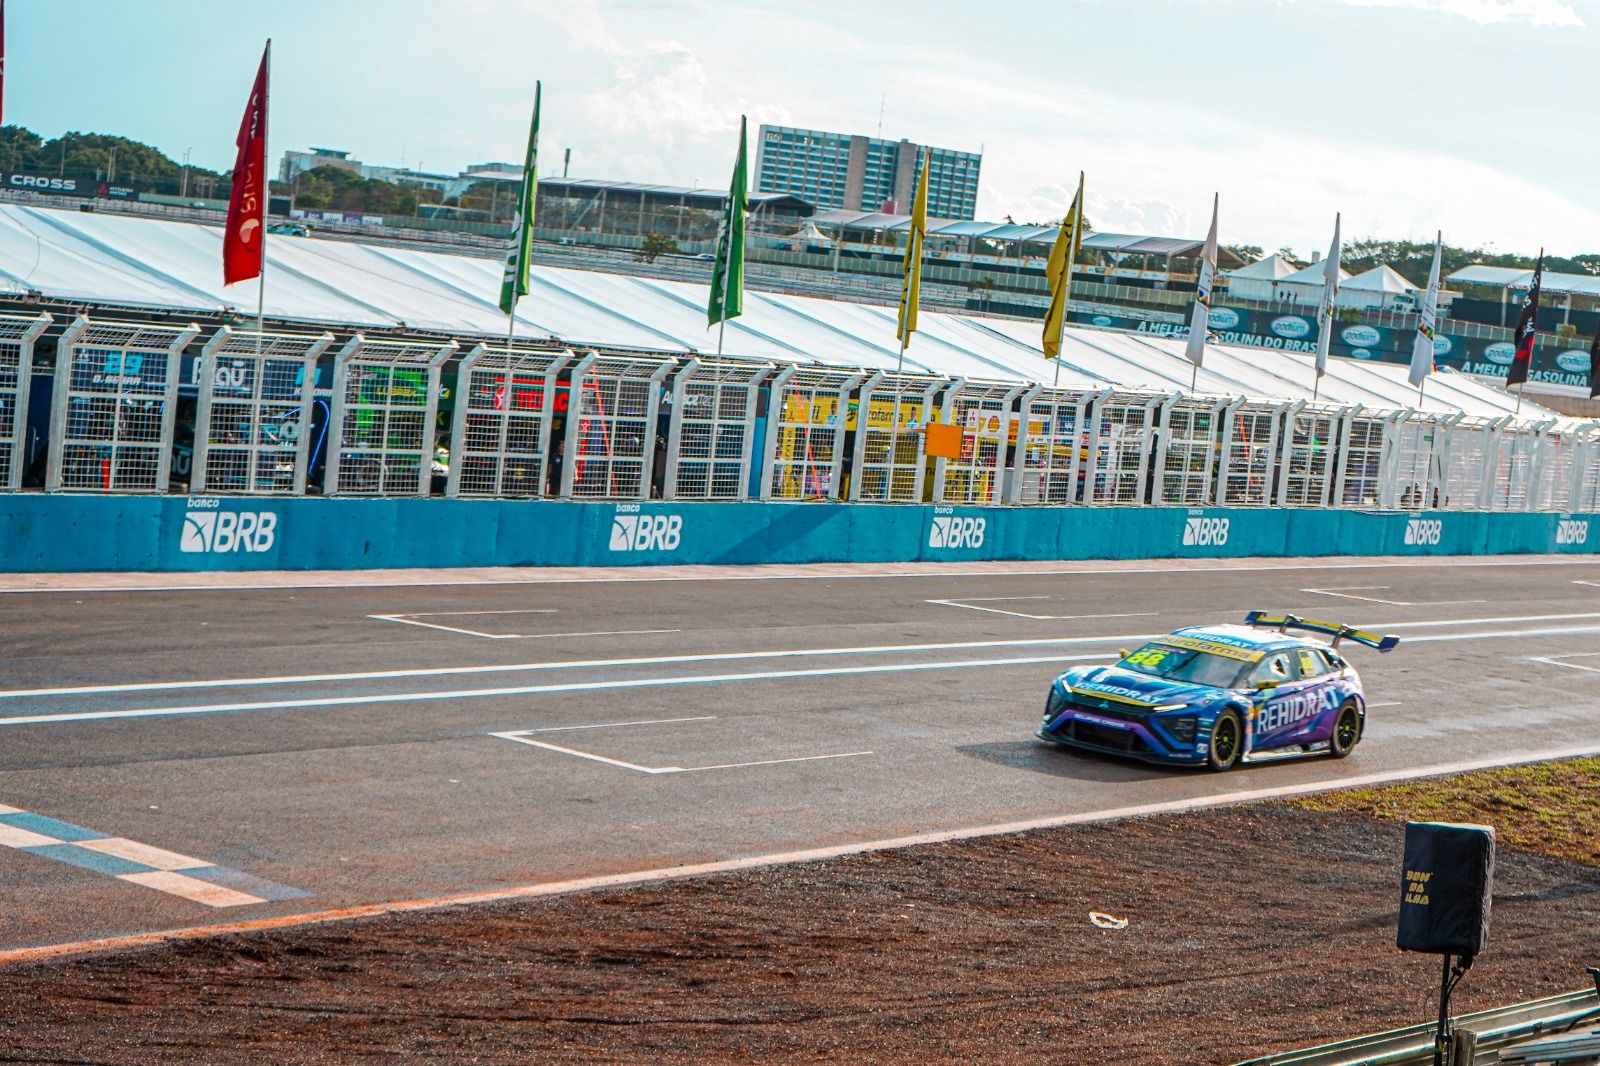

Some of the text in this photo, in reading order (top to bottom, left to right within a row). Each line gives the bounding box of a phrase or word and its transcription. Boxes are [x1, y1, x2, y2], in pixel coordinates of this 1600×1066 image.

[11, 175, 76, 190] CROSS
[1137, 321, 1146, 332] A
[1218, 331, 1262, 347] SOLINA
[1264, 336, 1283, 348] DO
[1284, 340, 1318, 353] BRAS
[1274, 322, 1305, 333] podium
[1345, 331, 1376, 342] podium
[104, 353, 144, 375] 29
[1461, 361, 1588, 386] A MELH GASOLINA
[187, 496, 219, 508] banco
[615, 503, 640, 513] banco
[213, 511, 277, 553] BRB
[634, 515, 683, 551] BRB
[947, 517, 986, 548] BRB
[1198, 517, 1230, 546] BRB
[1416, 519, 1442, 545] BRB
[1566, 520, 1588, 544] BRB
[1127, 651, 1165, 667] 88
[1161, 636, 1251, 660] eurofarma
[1074, 681, 1166, 704] REHIDRAT
[1257, 685, 1340, 735] REHIDRAT
